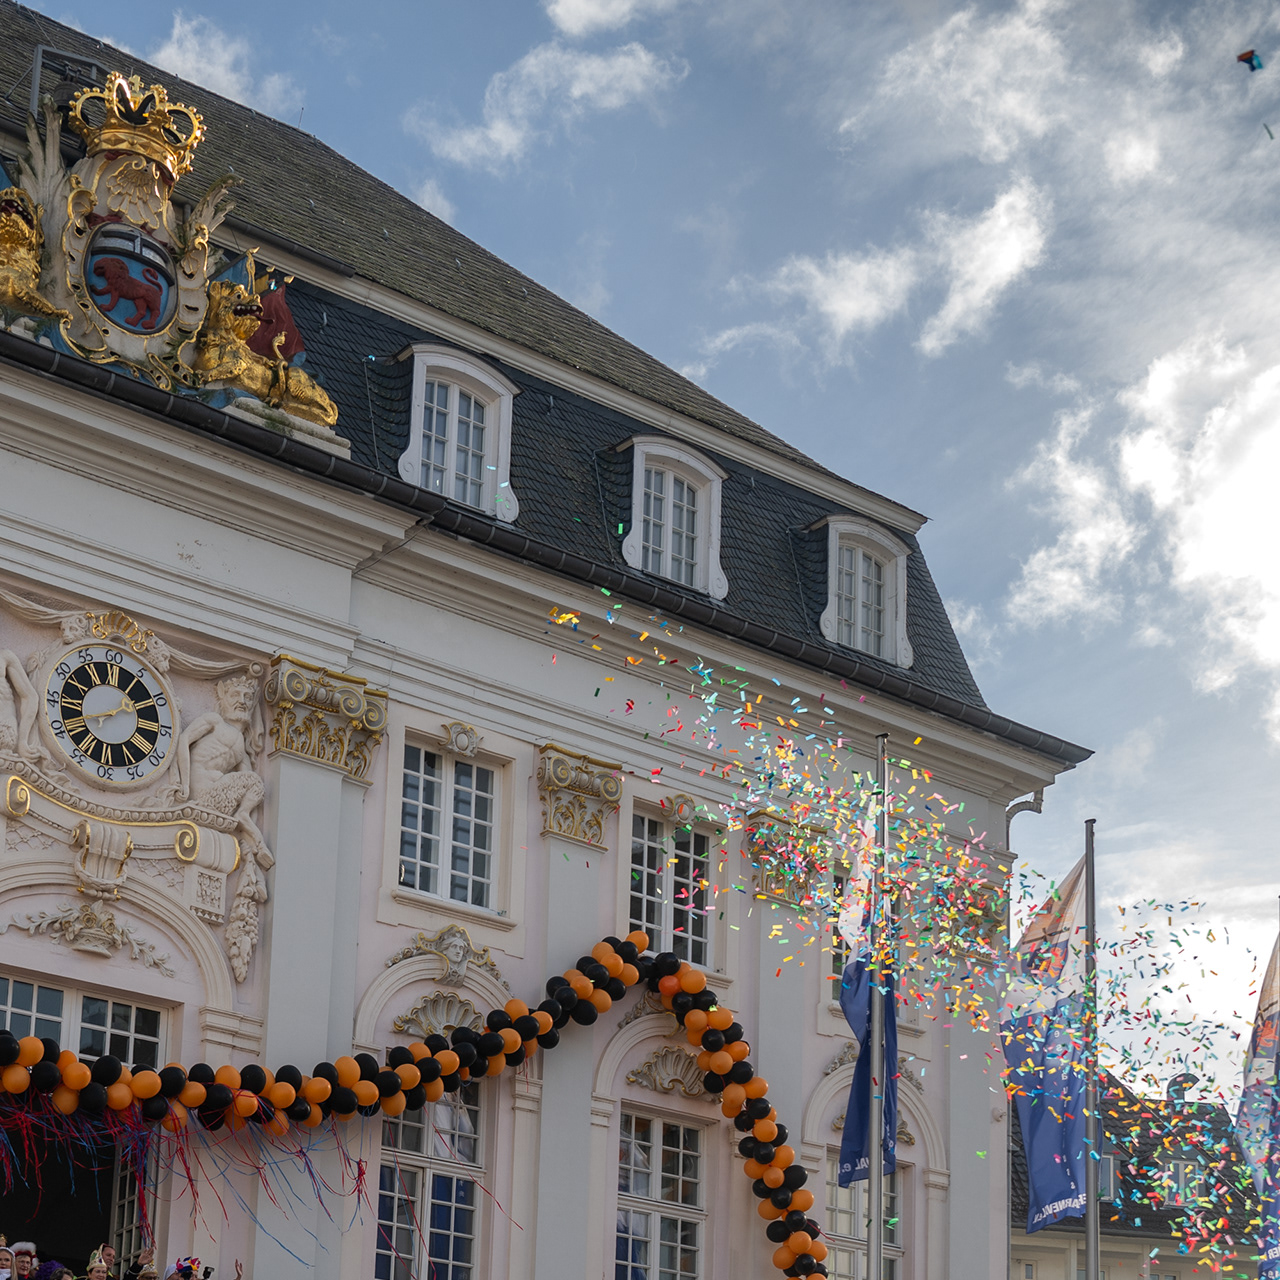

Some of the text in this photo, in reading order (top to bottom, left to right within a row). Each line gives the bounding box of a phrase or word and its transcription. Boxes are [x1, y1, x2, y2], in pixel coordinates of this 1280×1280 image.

[78, 648, 94, 664] 55
[106, 650, 123, 664] 60
[55, 662, 71, 680] 50
[84, 664, 101, 686] XI
[106, 664, 120, 687] XII
[136, 667, 148, 678] 5
[68, 674, 89, 696] X
[125, 677, 138, 694] I
[47, 689, 60, 708] 45
[135, 698, 155, 710] II
[153, 692, 167, 707] 10
[50, 720, 66, 740] 40
[138, 718, 159, 732] III
[159, 724, 172, 738] 15
[79, 732, 98, 756] VII
[130, 732, 154, 755] IIII
[69, 748, 88, 768] 35
[101, 744, 113, 765] VI
[122, 744, 136, 765] V
[148, 747, 166, 767] 20
[97, 766, 114, 781] 30
[126, 766, 144, 780] 25
